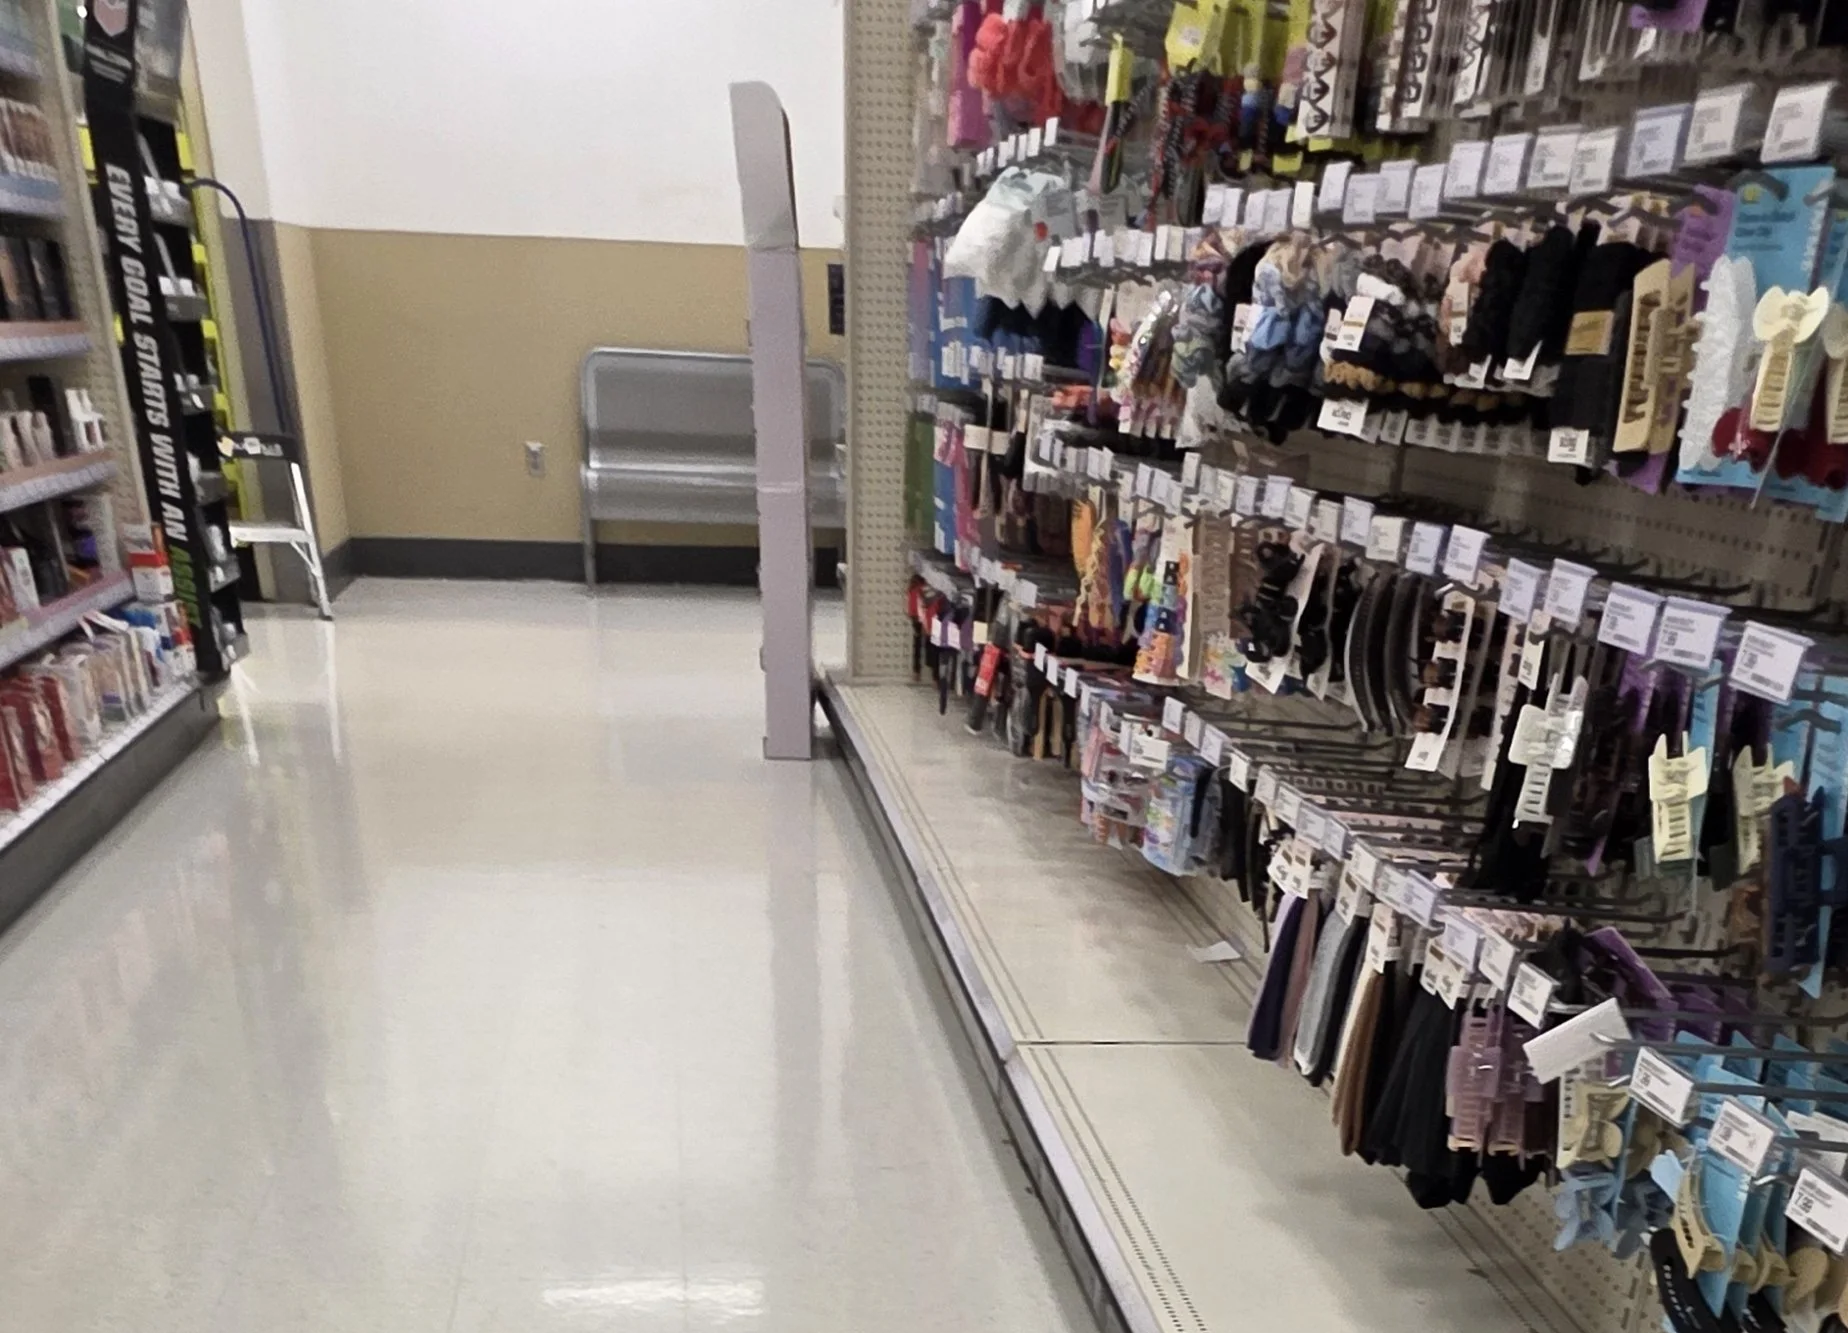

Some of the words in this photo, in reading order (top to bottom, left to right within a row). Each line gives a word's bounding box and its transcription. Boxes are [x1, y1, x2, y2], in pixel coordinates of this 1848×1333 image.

[105, 163, 142, 254] EVERY
[120, 256, 154, 324] GOAL
[133, 331, 170, 428] STARTS
[150, 432, 182, 499] WITH
[160, 501, 189, 542] AN
